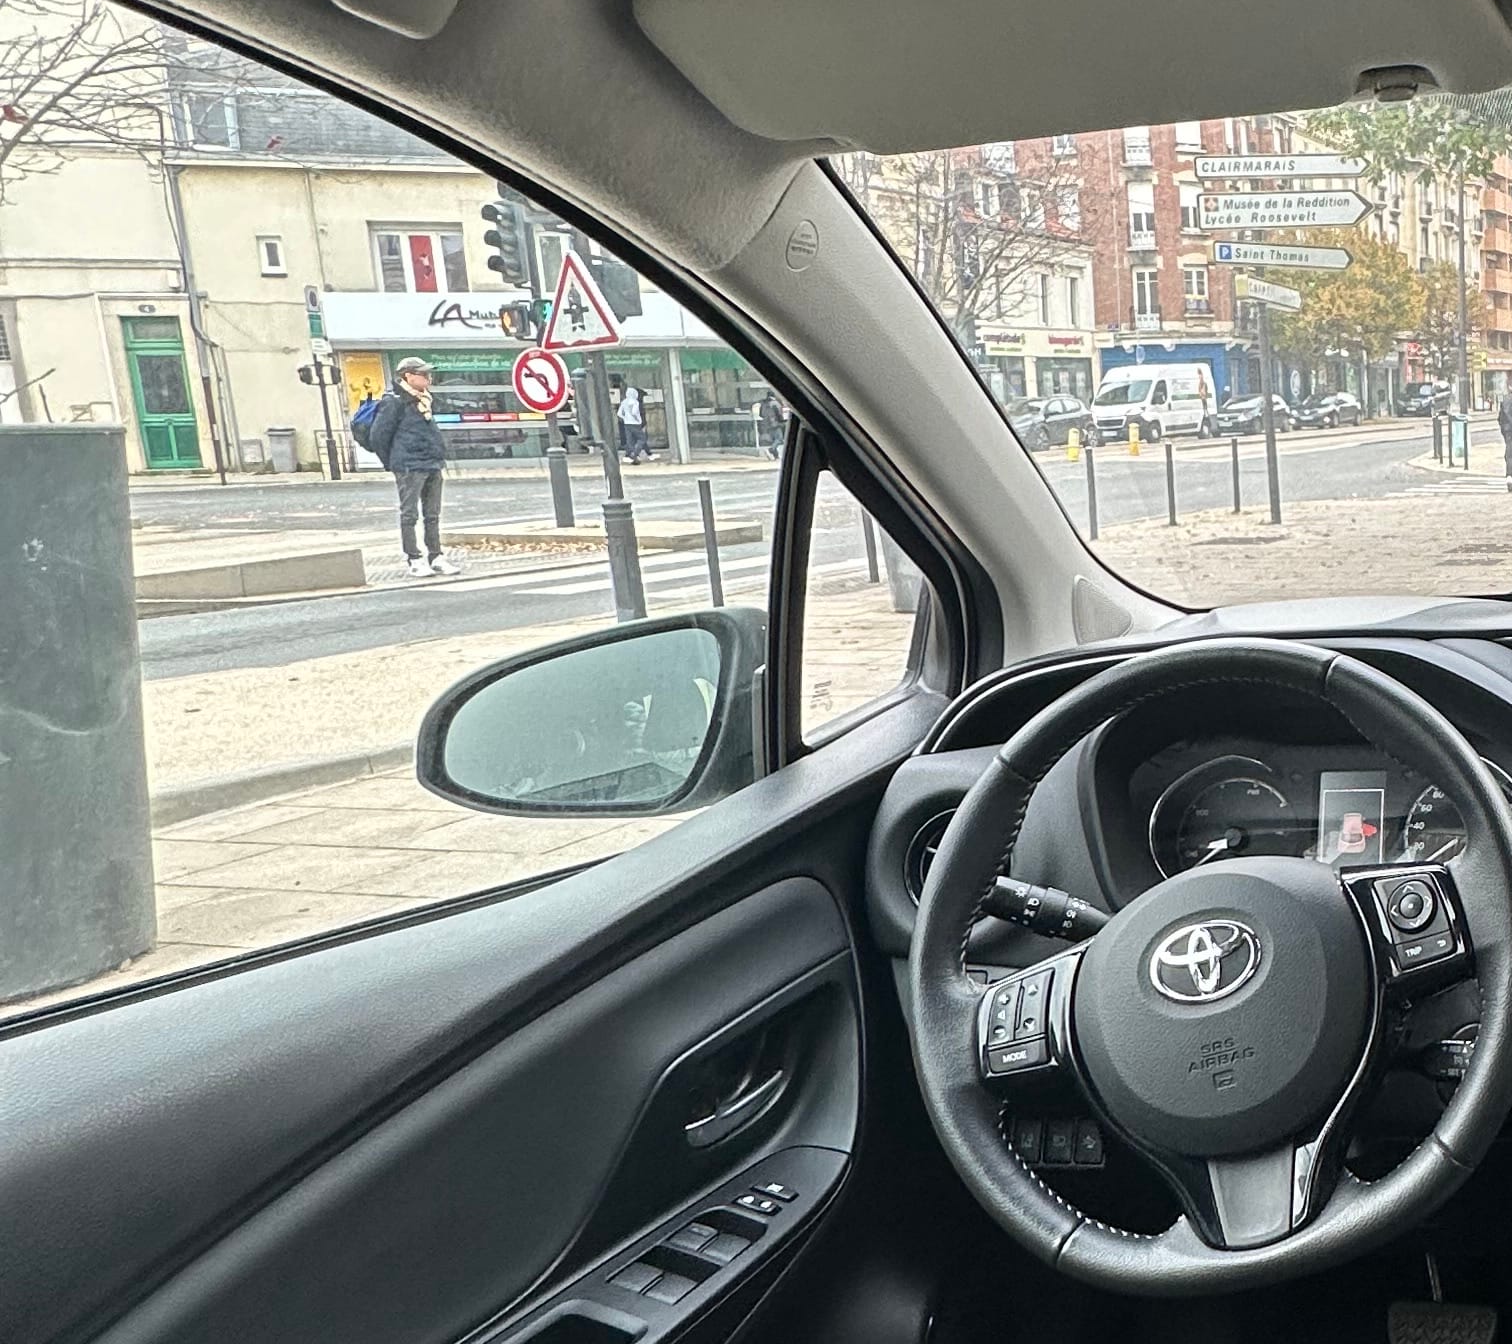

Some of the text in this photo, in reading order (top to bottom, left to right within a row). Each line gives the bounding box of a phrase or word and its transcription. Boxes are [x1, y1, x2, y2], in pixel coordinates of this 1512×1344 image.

[1201, 159, 1296, 173] CLAIRMARAIS
[1223, 196, 1350, 210] Musée de la Reddition
[1205, 212, 1316, 226] Lycée Roosevelt
[1234, 247, 1265, 260] Saint
[1270, 249, 1309, 263] Thomas
[1420, 803, 1433, 812] 60
[1413, 821, 1425, 830] 40
[1405, 945, 1422, 957] TRIP
[1200, 1037, 1235, 1054] SRS
[1002, 1050, 1027, 1064] MODE
[1188, 1046, 1255, 1073] AIRBAG
